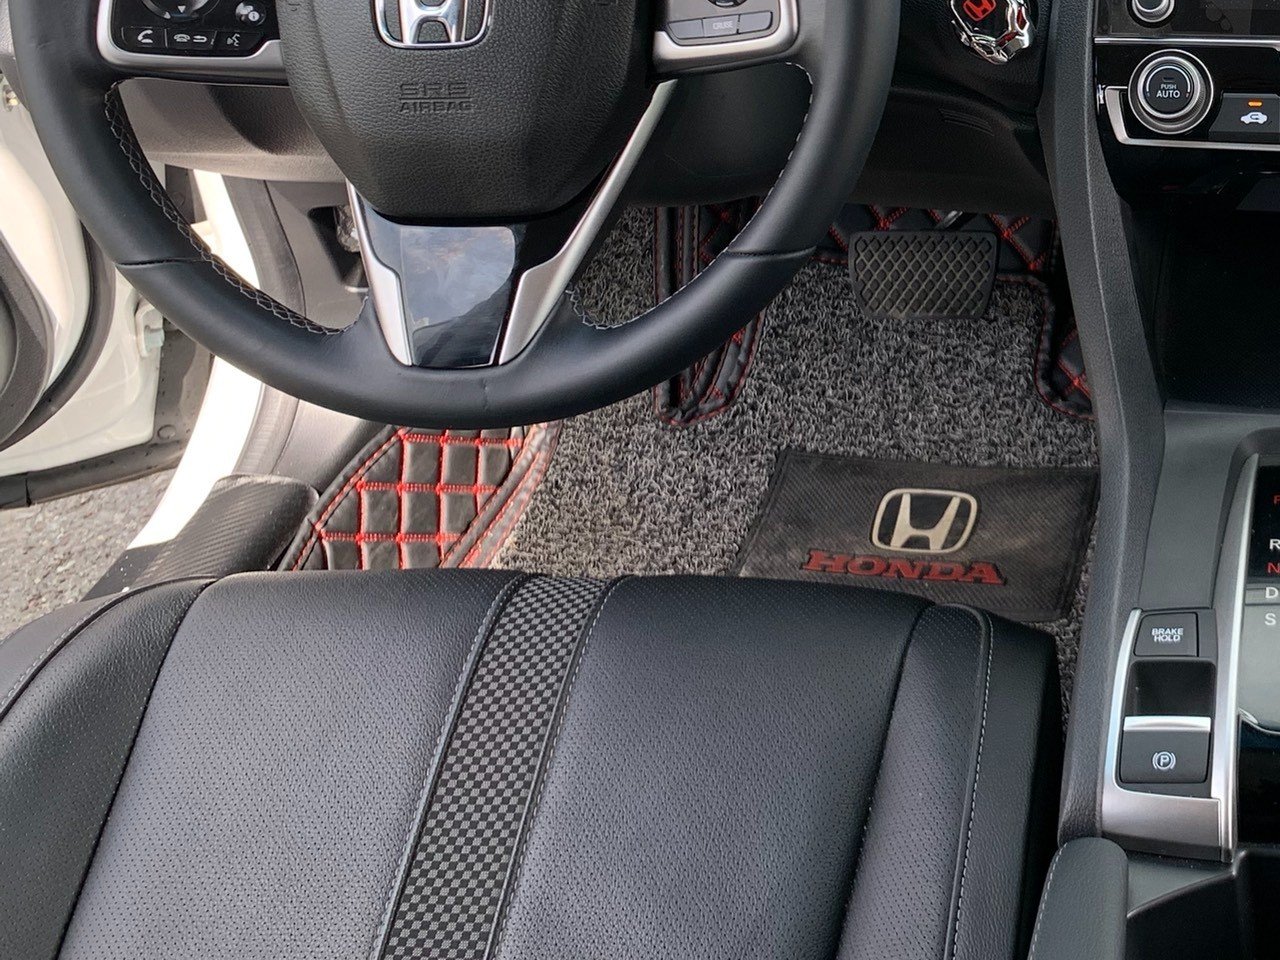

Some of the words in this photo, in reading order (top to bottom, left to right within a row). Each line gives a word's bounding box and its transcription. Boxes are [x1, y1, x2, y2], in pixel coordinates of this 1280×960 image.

[712, 20, 733, 30] CRUISE
[1156, 90, 1181, 98] AUTO
[801, 548, 1006, 586] HONDA
[1265, 586, 1279, 599] D
[1264, 612, 1277, 626] S
[1151, 627, 1184, 635] BRAKE
[1153, 634, 1181, 642] HOLD
